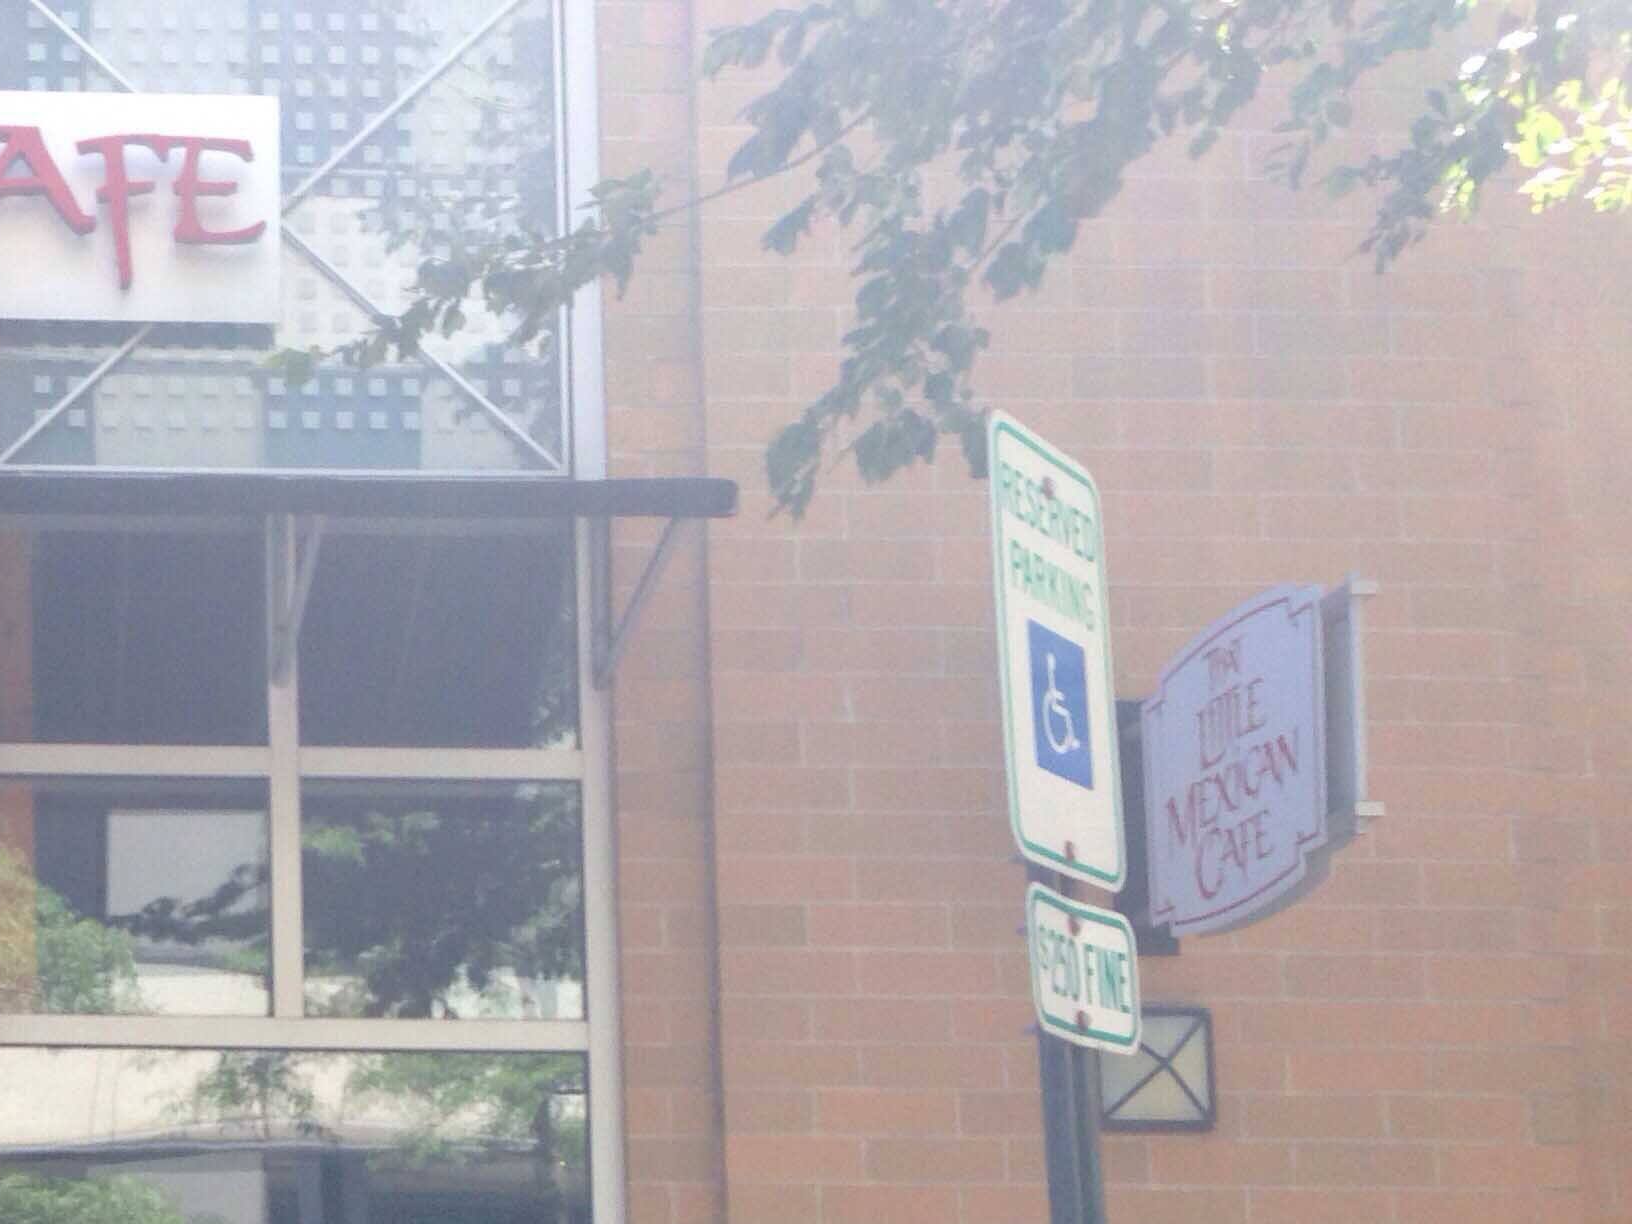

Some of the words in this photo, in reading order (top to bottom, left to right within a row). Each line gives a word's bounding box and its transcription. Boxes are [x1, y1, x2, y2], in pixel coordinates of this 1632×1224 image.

[996, 460, 1097, 562] RESERVED
[1009, 538, 1096, 632] PARKING
[1166, 726, 1299, 848] MEXICAN
[1194, 809, 1272, 900] CAFE
[1083, 943, 1132, 1014] FINE
